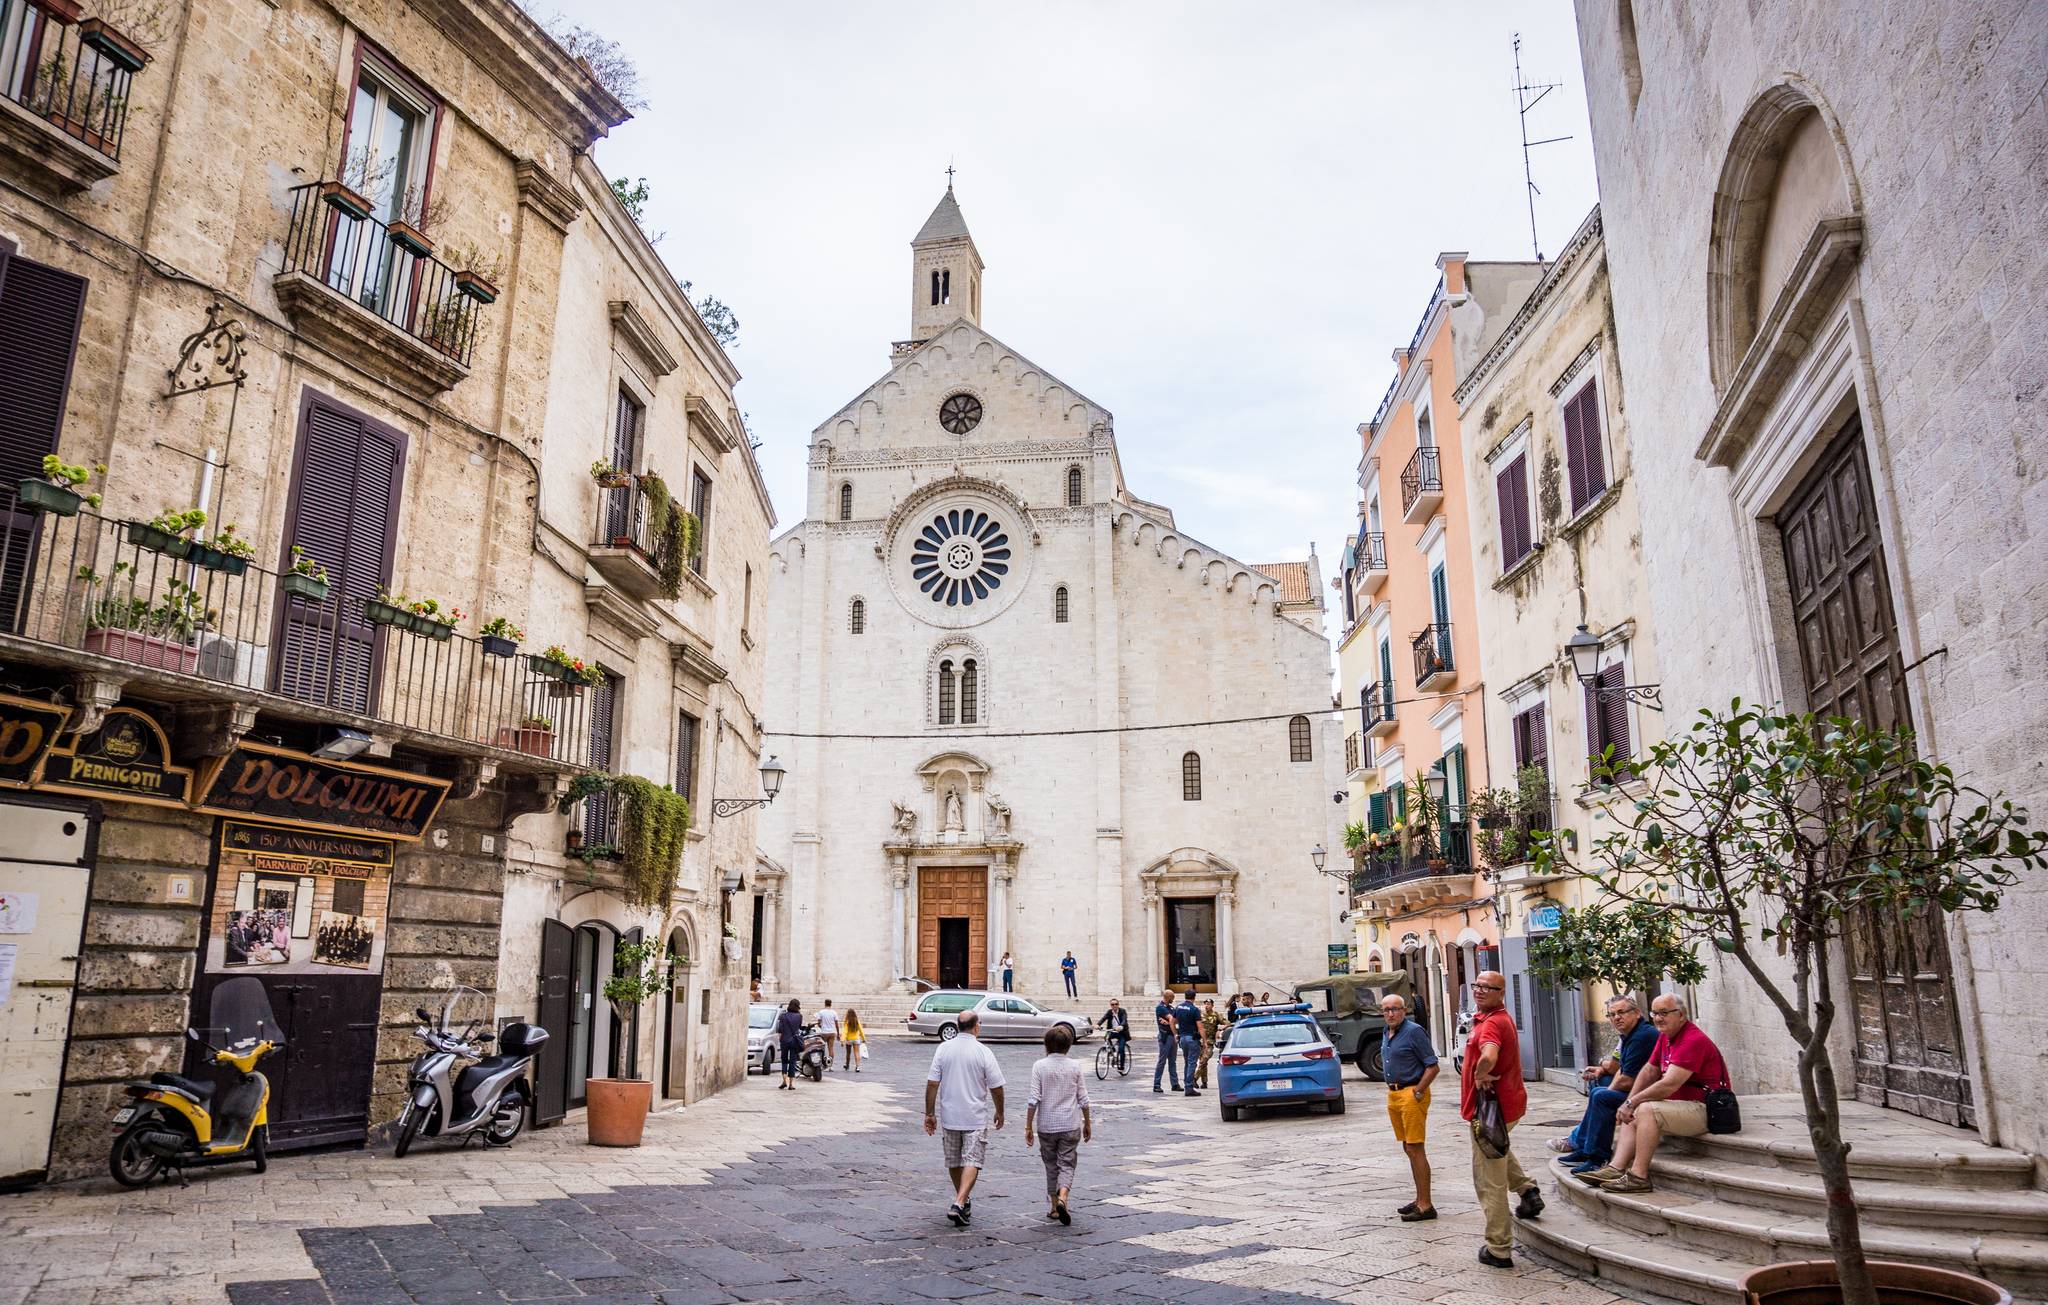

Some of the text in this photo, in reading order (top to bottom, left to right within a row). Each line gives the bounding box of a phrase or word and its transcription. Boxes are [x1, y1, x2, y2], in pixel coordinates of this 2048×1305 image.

[70, 758, 161, 788] PERNIGOTTI
[231, 758, 428, 820] DOLCIUMI
[284, 836, 363, 857] ANNIVERSARIO
[256, 859, 307, 873] MARNARID
[334, 865, 369, 878] DOLCIUMI
